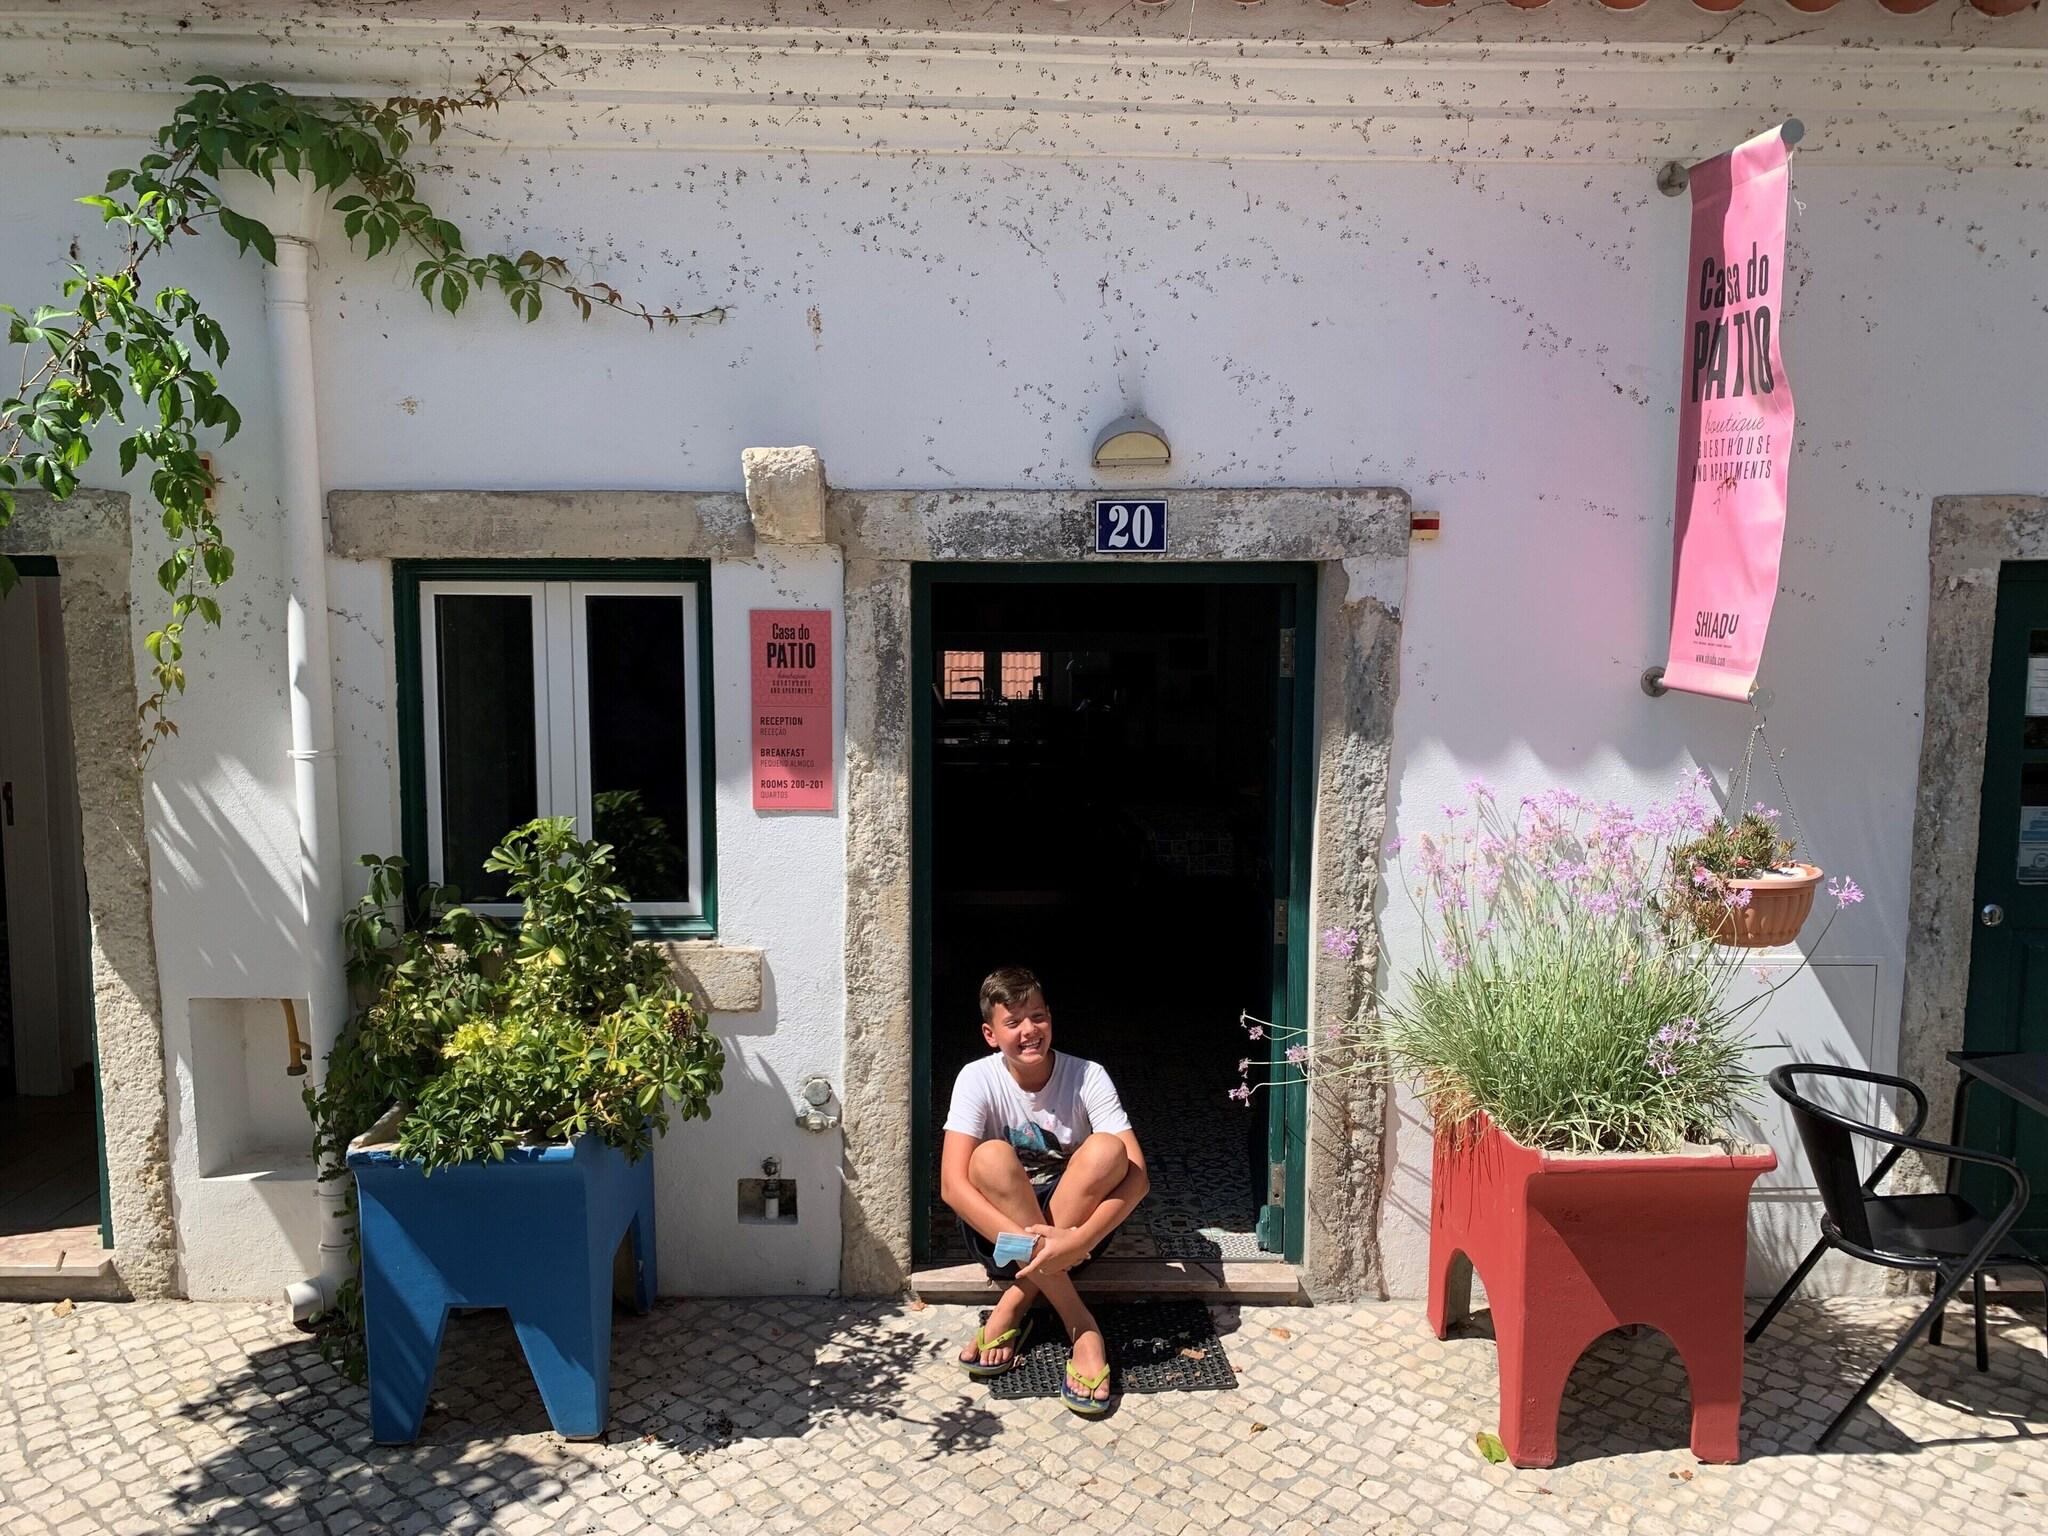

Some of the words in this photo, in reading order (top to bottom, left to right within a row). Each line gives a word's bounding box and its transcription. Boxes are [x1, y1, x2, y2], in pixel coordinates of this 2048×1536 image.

[1700, 256, 1740, 311] Casa
[1747, 241, 1769, 300] do
[1705, 409, 1766, 445] boutique
[1697, 434, 1771, 459] GUESTHOUSE
[1710, 460, 1772, 482] APARTMENTS
[1108, 505, 1153, 548] 20
[772, 623, 796, 640] Casa
[798, 623, 810, 640] do
[1695, 611, 1740, 639] SHIADU
[760, 716, 803, 726] RECEPTION
[760, 748, 805, 758] BREAKFAST
[760, 779, 788, 789] ROOMS
[791, 779, 824, 789] 200-201
